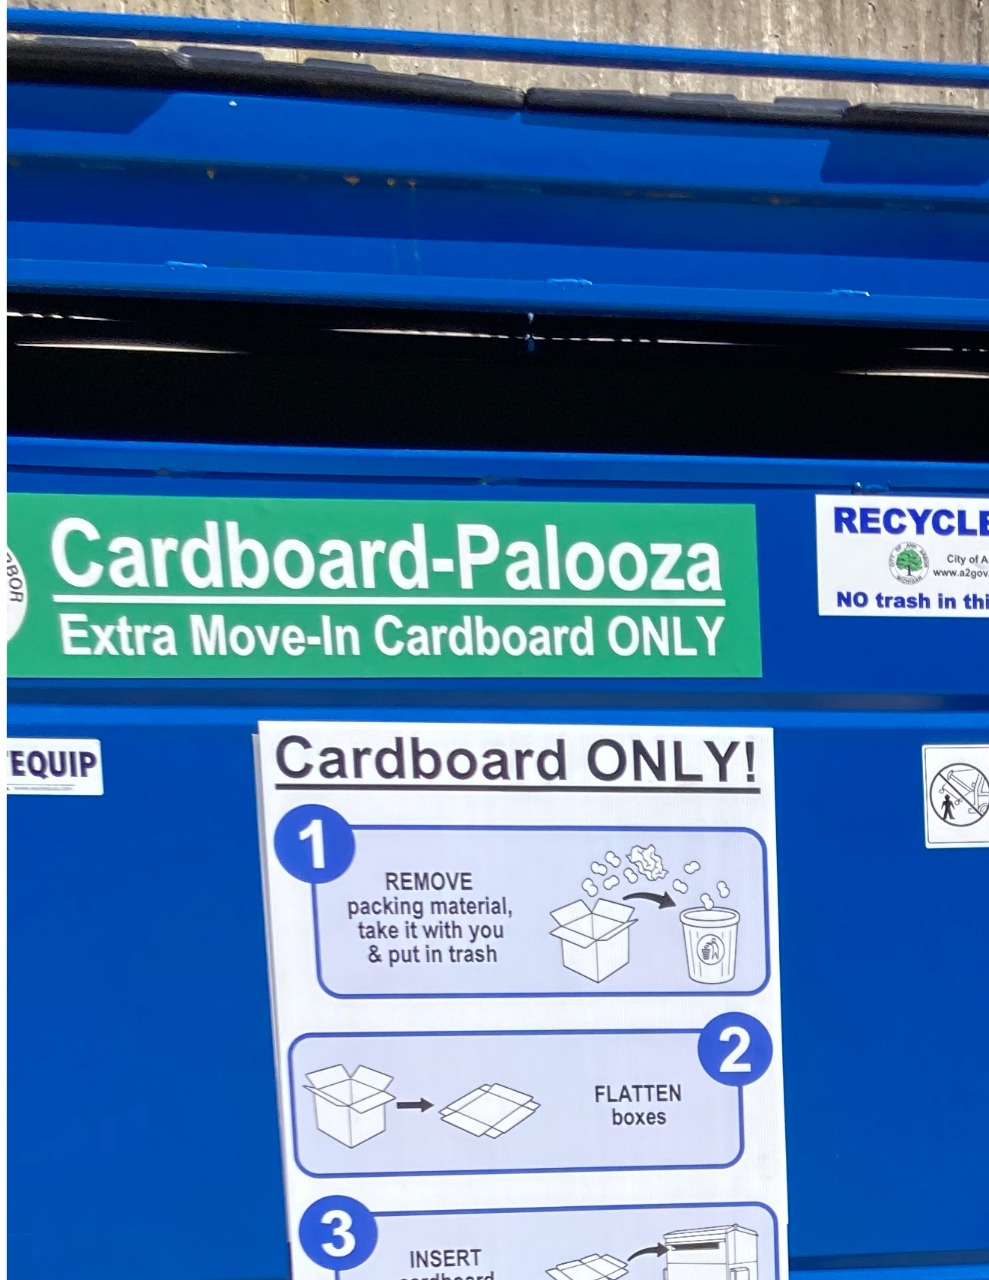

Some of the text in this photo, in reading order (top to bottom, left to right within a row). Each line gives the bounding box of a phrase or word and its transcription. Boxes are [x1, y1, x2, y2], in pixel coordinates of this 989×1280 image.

[51, 516, 724, 593] Cardboard-Palooza
[947, 554, 966, 565] City
[969, 554, 978, 564] of
[836, 591, 868, 608] NO
[875, 592, 930, 609] trash
[938, 593, 956, 609] in
[61, 613, 726, 658] Extra Move-In Cardboard ONLY
[7, 750, 97, 780] EQUIP
[275, 735, 758, 783] Cardboard ONLY!
[298, 819, 326, 869] 1
[385, 872, 473, 891] REMOVE
[347, 896, 513, 919] packing material,
[358, 920, 505, 943] take it with you
[368, 944, 498, 967] & put in trash
[719, 1026, 752, 1073] 2
[594, 1084, 682, 1104] FLATTEN
[611, 1107, 667, 1126] boxes
[320, 1209, 356, 1257] 3
[410, 1248, 482, 1269] INSERT
